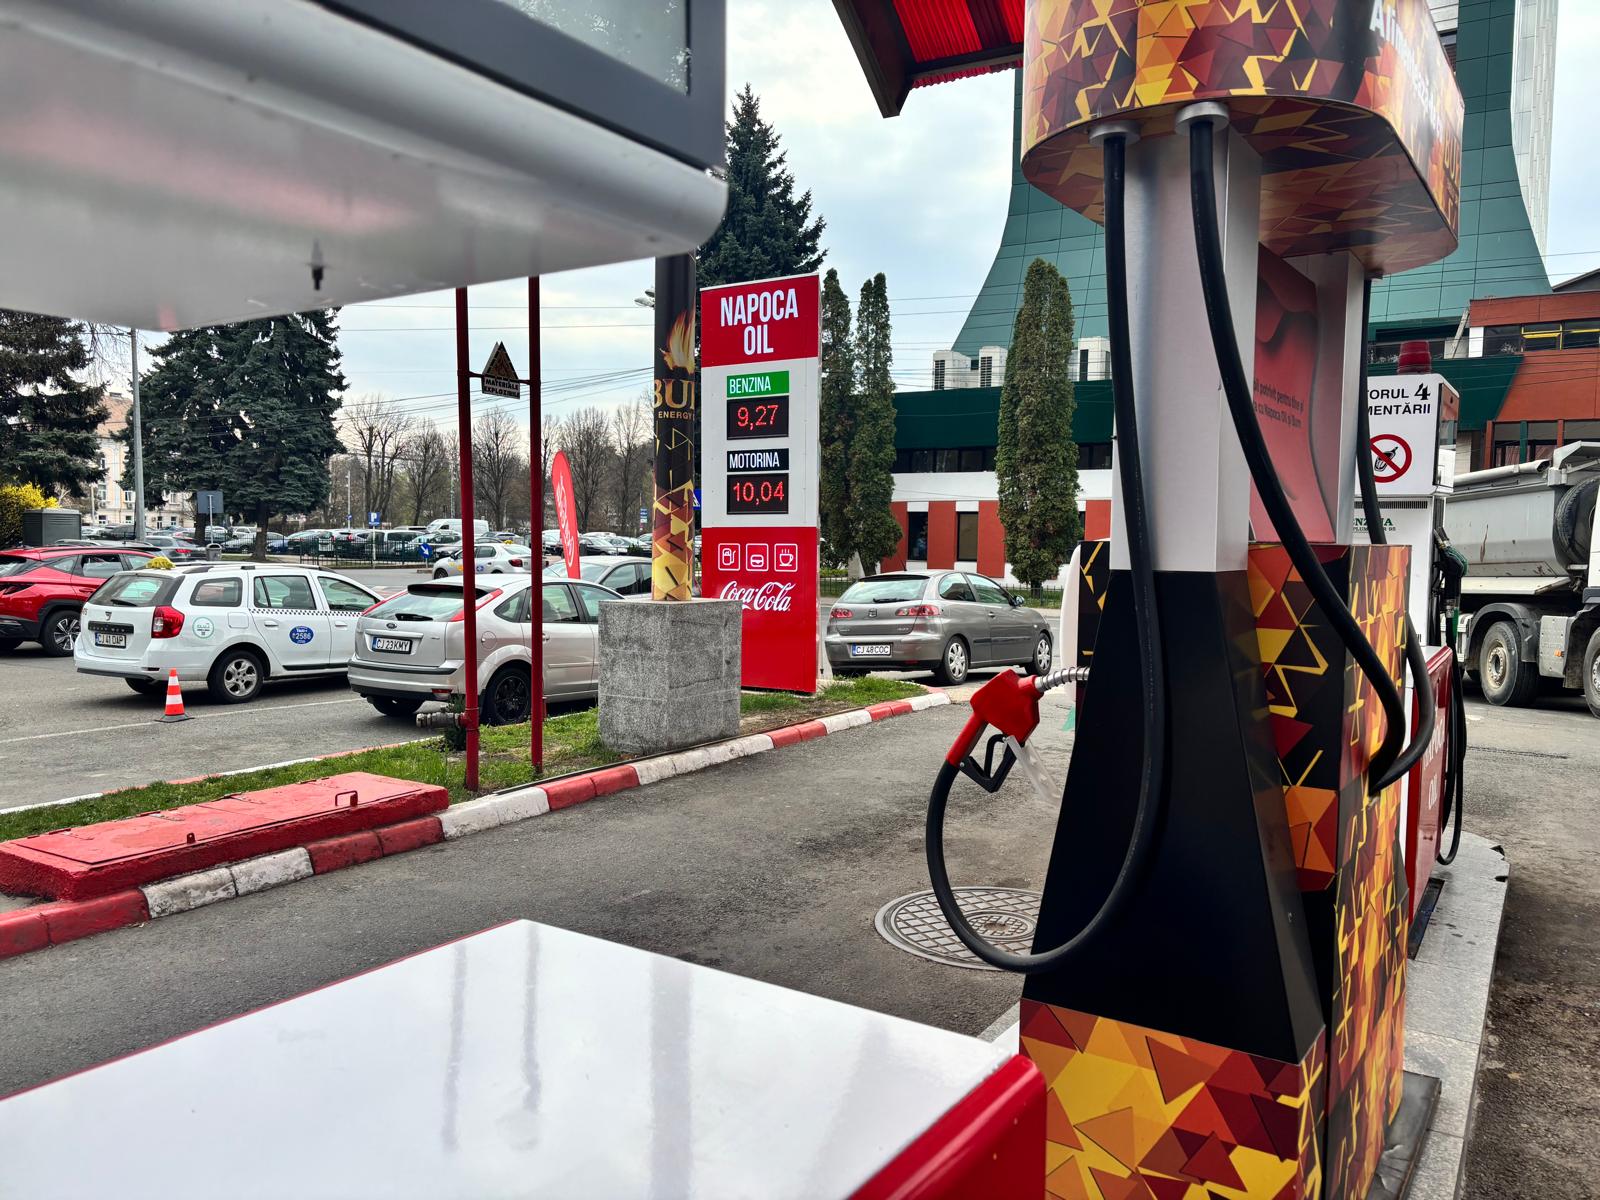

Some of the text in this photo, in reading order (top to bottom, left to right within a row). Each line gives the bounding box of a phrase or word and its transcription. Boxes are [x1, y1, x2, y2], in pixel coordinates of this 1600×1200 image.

[720, 288, 799, 327] NAPOCA
[743, 324, 774, 356] OIL
[729, 376, 771, 394] BENZINA
[1368, 388, 1409, 400] ORUL
[1414, 382, 1431, 400] 4
[737, 404, 779, 430] 9,27
[729, 452, 780, 468] MOTORINA
[733, 481, 784, 505] 10,04
[720, 580, 796, 611] Coca-Cola
